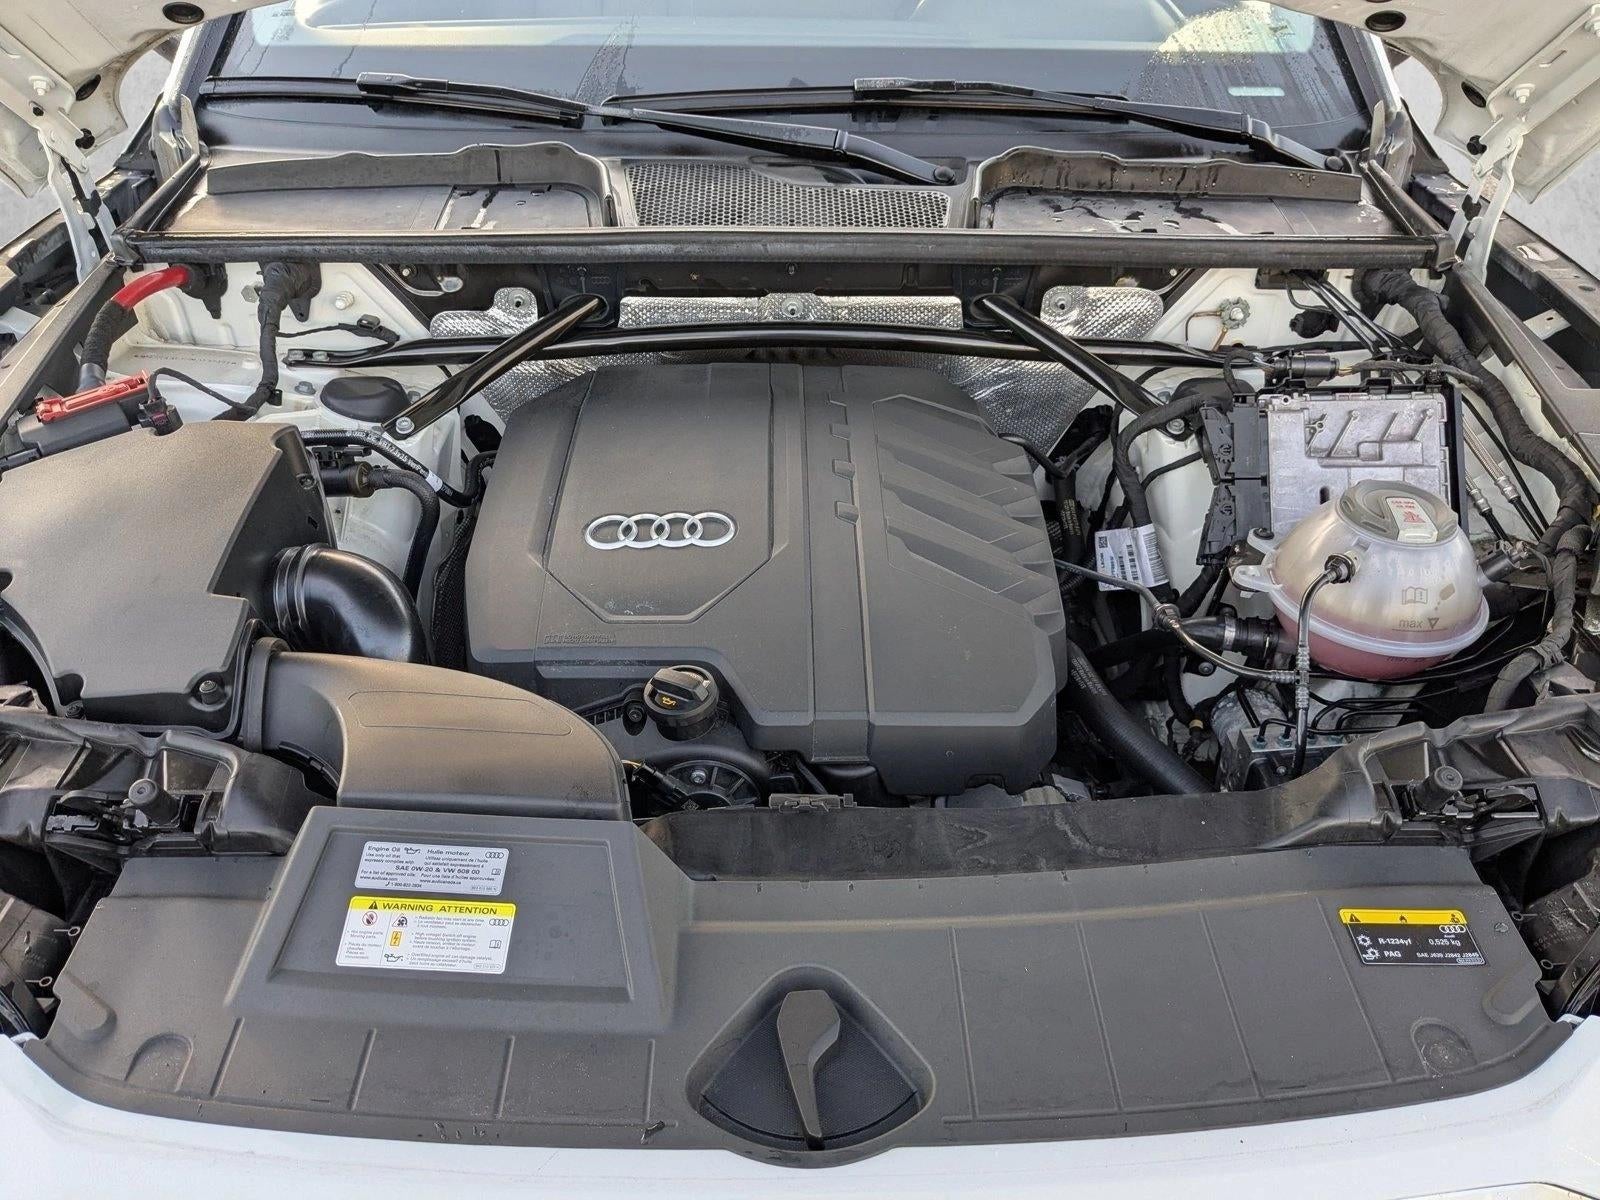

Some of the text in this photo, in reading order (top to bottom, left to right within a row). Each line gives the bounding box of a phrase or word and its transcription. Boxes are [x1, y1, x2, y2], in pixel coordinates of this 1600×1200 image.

[1398, 617, 1424, 630] max
[382, 902, 498, 914] WARNING ATTENTION
[1378, 938, 1461, 947] R-1234yf 0,525 kg
